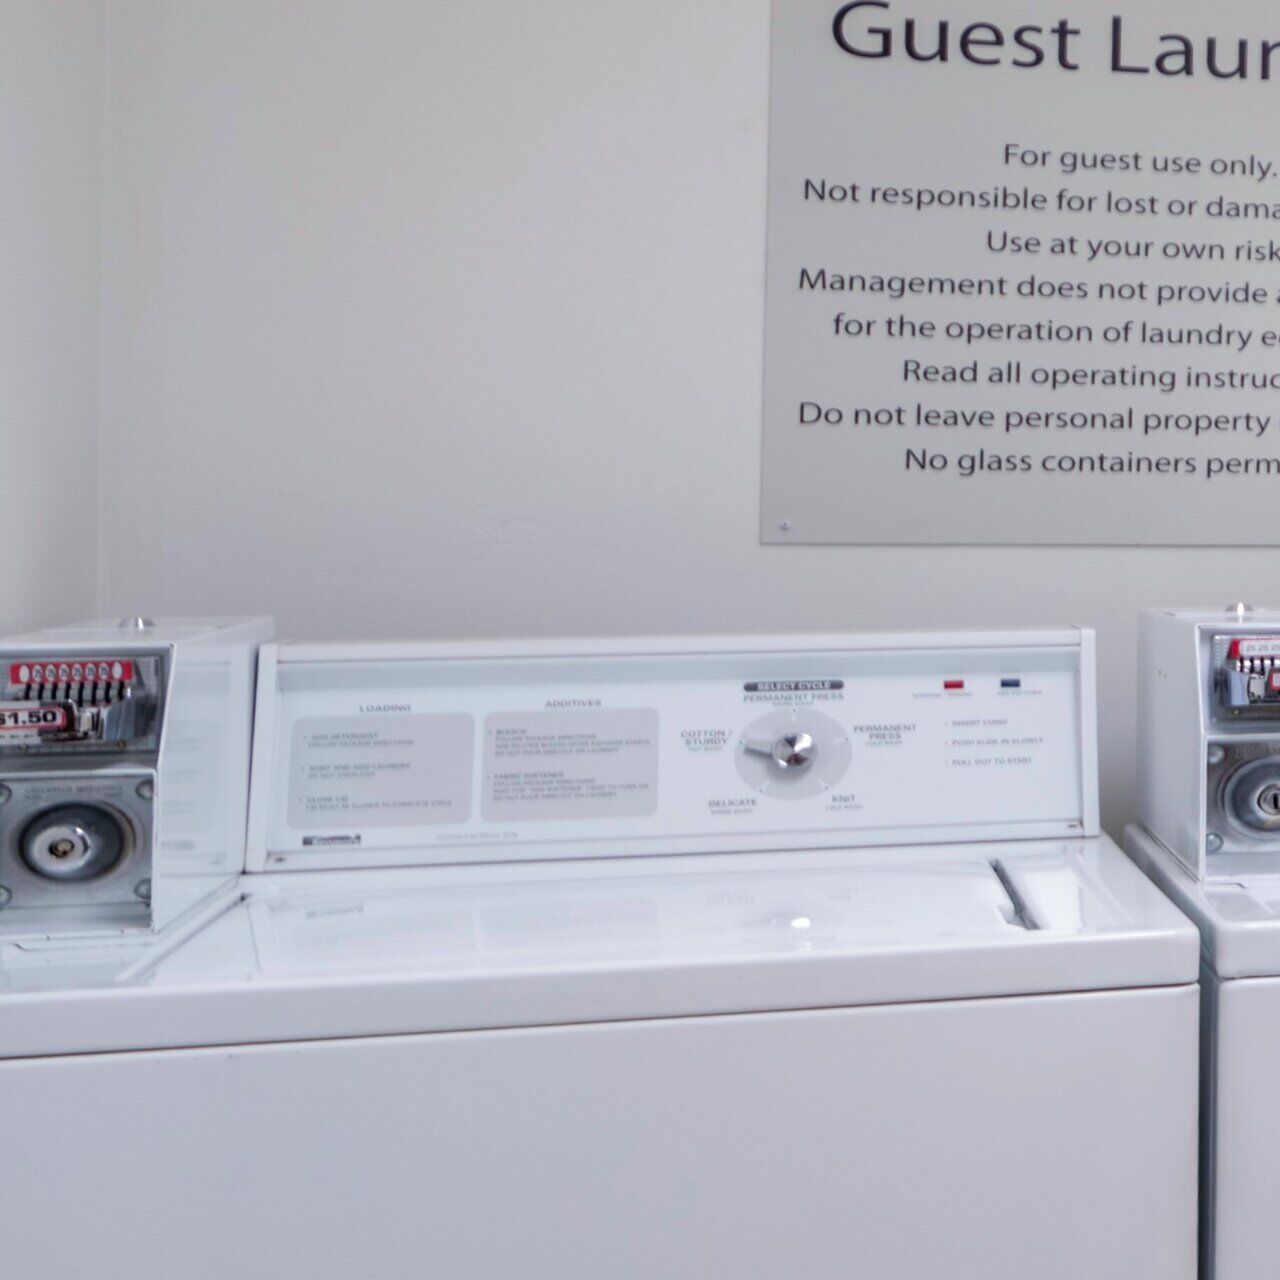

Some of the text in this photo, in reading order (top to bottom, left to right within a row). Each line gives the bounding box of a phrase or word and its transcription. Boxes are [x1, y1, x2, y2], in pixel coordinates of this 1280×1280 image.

[832, 0, 1080, 70] Guest
[1005, 144, 1277, 181] For guest use only.
[805, 179, 859, 202] Not
[871, 187, 1047, 211] responsible
[1057, 190, 1096, 211] for
[1108, 192, 1157, 214] lost
[1168, 200, 1196, 215] or
[988, 231, 1040, 253] Use
[1051, 237, 1076, 254] at
[1088, 241, 1153, 260] your
[1163, 243, 1224, 259] own
[799, 268, 1007, 298] Management
[1017, 275, 1087, 298] does
[1099, 282, 1146, 300] not
[1158, 283, 1266, 305] provide
[834, 313, 873, 334] for
[885, 316, 935, 337] the
[946, 320, 1092, 344] operation
[1103, 321, 1132, 342] of
[1142, 322, 1251, 351] laundry
[904, 360, 977, 382] Read
[988, 362, 1020, 383] all
[1031, 366, 1175, 392] operating
[800, 402, 843, 424] Do
[854, 407, 905, 425] not
[917, 403, 994, 426] leave
[1006, 408, 1132, 433] personal
[1144, 414, 1270, 436] property
[906, 449, 947, 470] No
[958, 449, 1031, 476] glass
[1042, 452, 1196, 473] containers
[757, 681, 831, 691] SELECT CYCLE
[743, 692, 844, 702] PERMANENT PRESS
[359, 703, 411, 713] LOADING
[545, 699, 602, 708] ADDITIVES
[853, 724, 917, 733] PERMANENT
[680, 730, 725, 738] COTTON
[868, 732, 902, 740] PRESS
[685, 737, 729, 746] STURDY
[952, 758, 972, 766] PULL
[708, 799, 757, 807] DELICATE
[832, 795, 856, 803] KNIT
